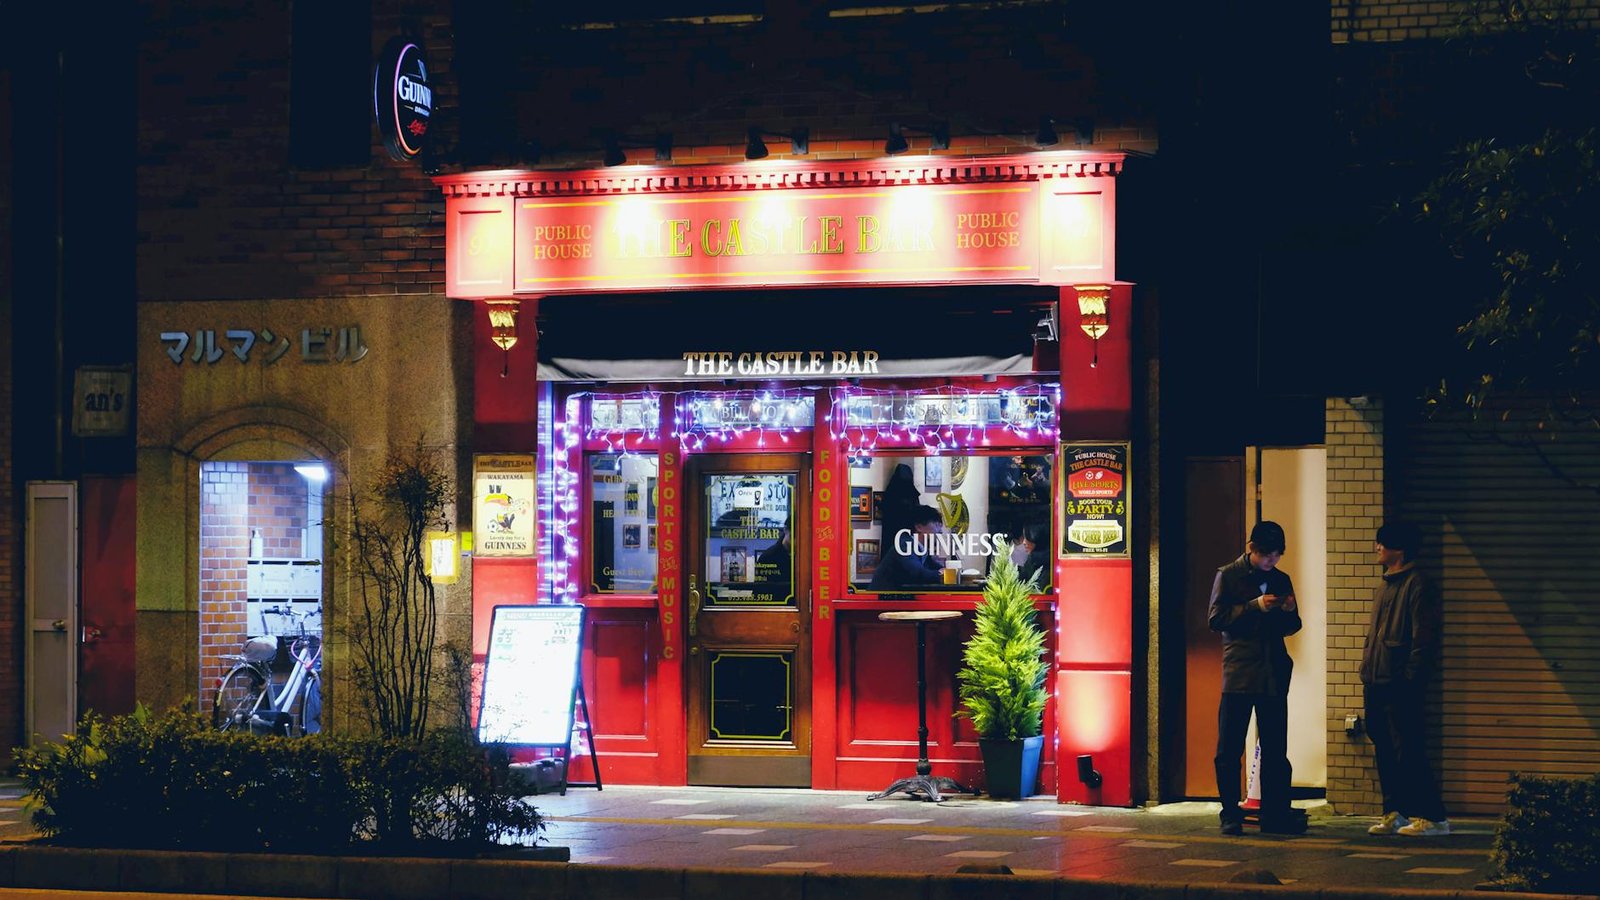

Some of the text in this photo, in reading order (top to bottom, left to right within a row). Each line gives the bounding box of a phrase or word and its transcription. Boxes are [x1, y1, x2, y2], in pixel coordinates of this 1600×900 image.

[958, 212, 1019, 234] PUBLIC
[534, 225, 591, 247] PUBLIC
[701, 216, 844, 257] CASTLE
[858, 213, 935, 253] BAR
[958, 232, 1020, 254] HOUSE
[534, 244, 592, 267] HOUSE
[160, 328, 370, 366] マルマンビル
[683, 350, 879, 376] THE CASTLE BAR
[1070, 459, 1123, 471] THE CASTLE BAR
[1075, 452, 1116, 461] PUBLIC HOUSE
[819, 450, 832, 522] FOOD
[664, 452, 675, 551] SPORTS
[1077, 505, 1114, 514] PARTY
[740, 516, 758, 527] THE
[485, 541, 526, 550] GUINNESS
[721, 529, 780, 540] CASTLE BAR
[894, 529, 1002, 558] GUINNESS
[819, 547, 831, 620] BEER
[663, 577, 675, 660] MUSIC
